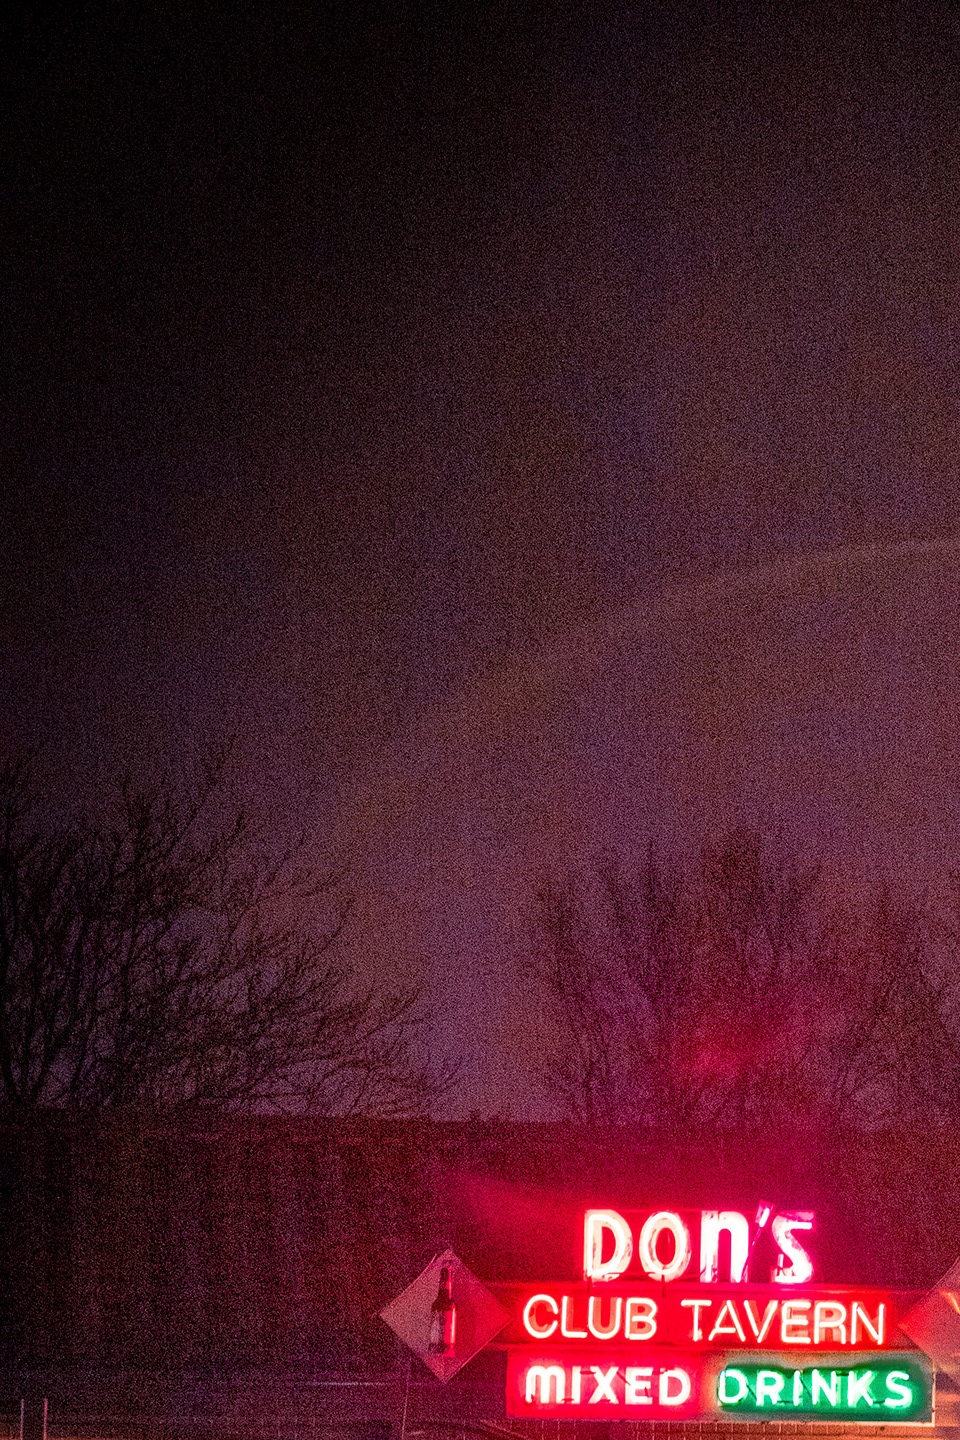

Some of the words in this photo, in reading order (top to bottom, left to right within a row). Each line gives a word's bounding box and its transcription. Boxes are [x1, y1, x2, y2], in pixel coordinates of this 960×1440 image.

[584, 1203, 816, 1283] DON'S
[522, 1293, 658, 1341] CLUB
[680, 1297, 887, 1345] TAVERN
[523, 1364, 691, 1406] MIXED
[716, 1368, 913, 1408] DRINKS
